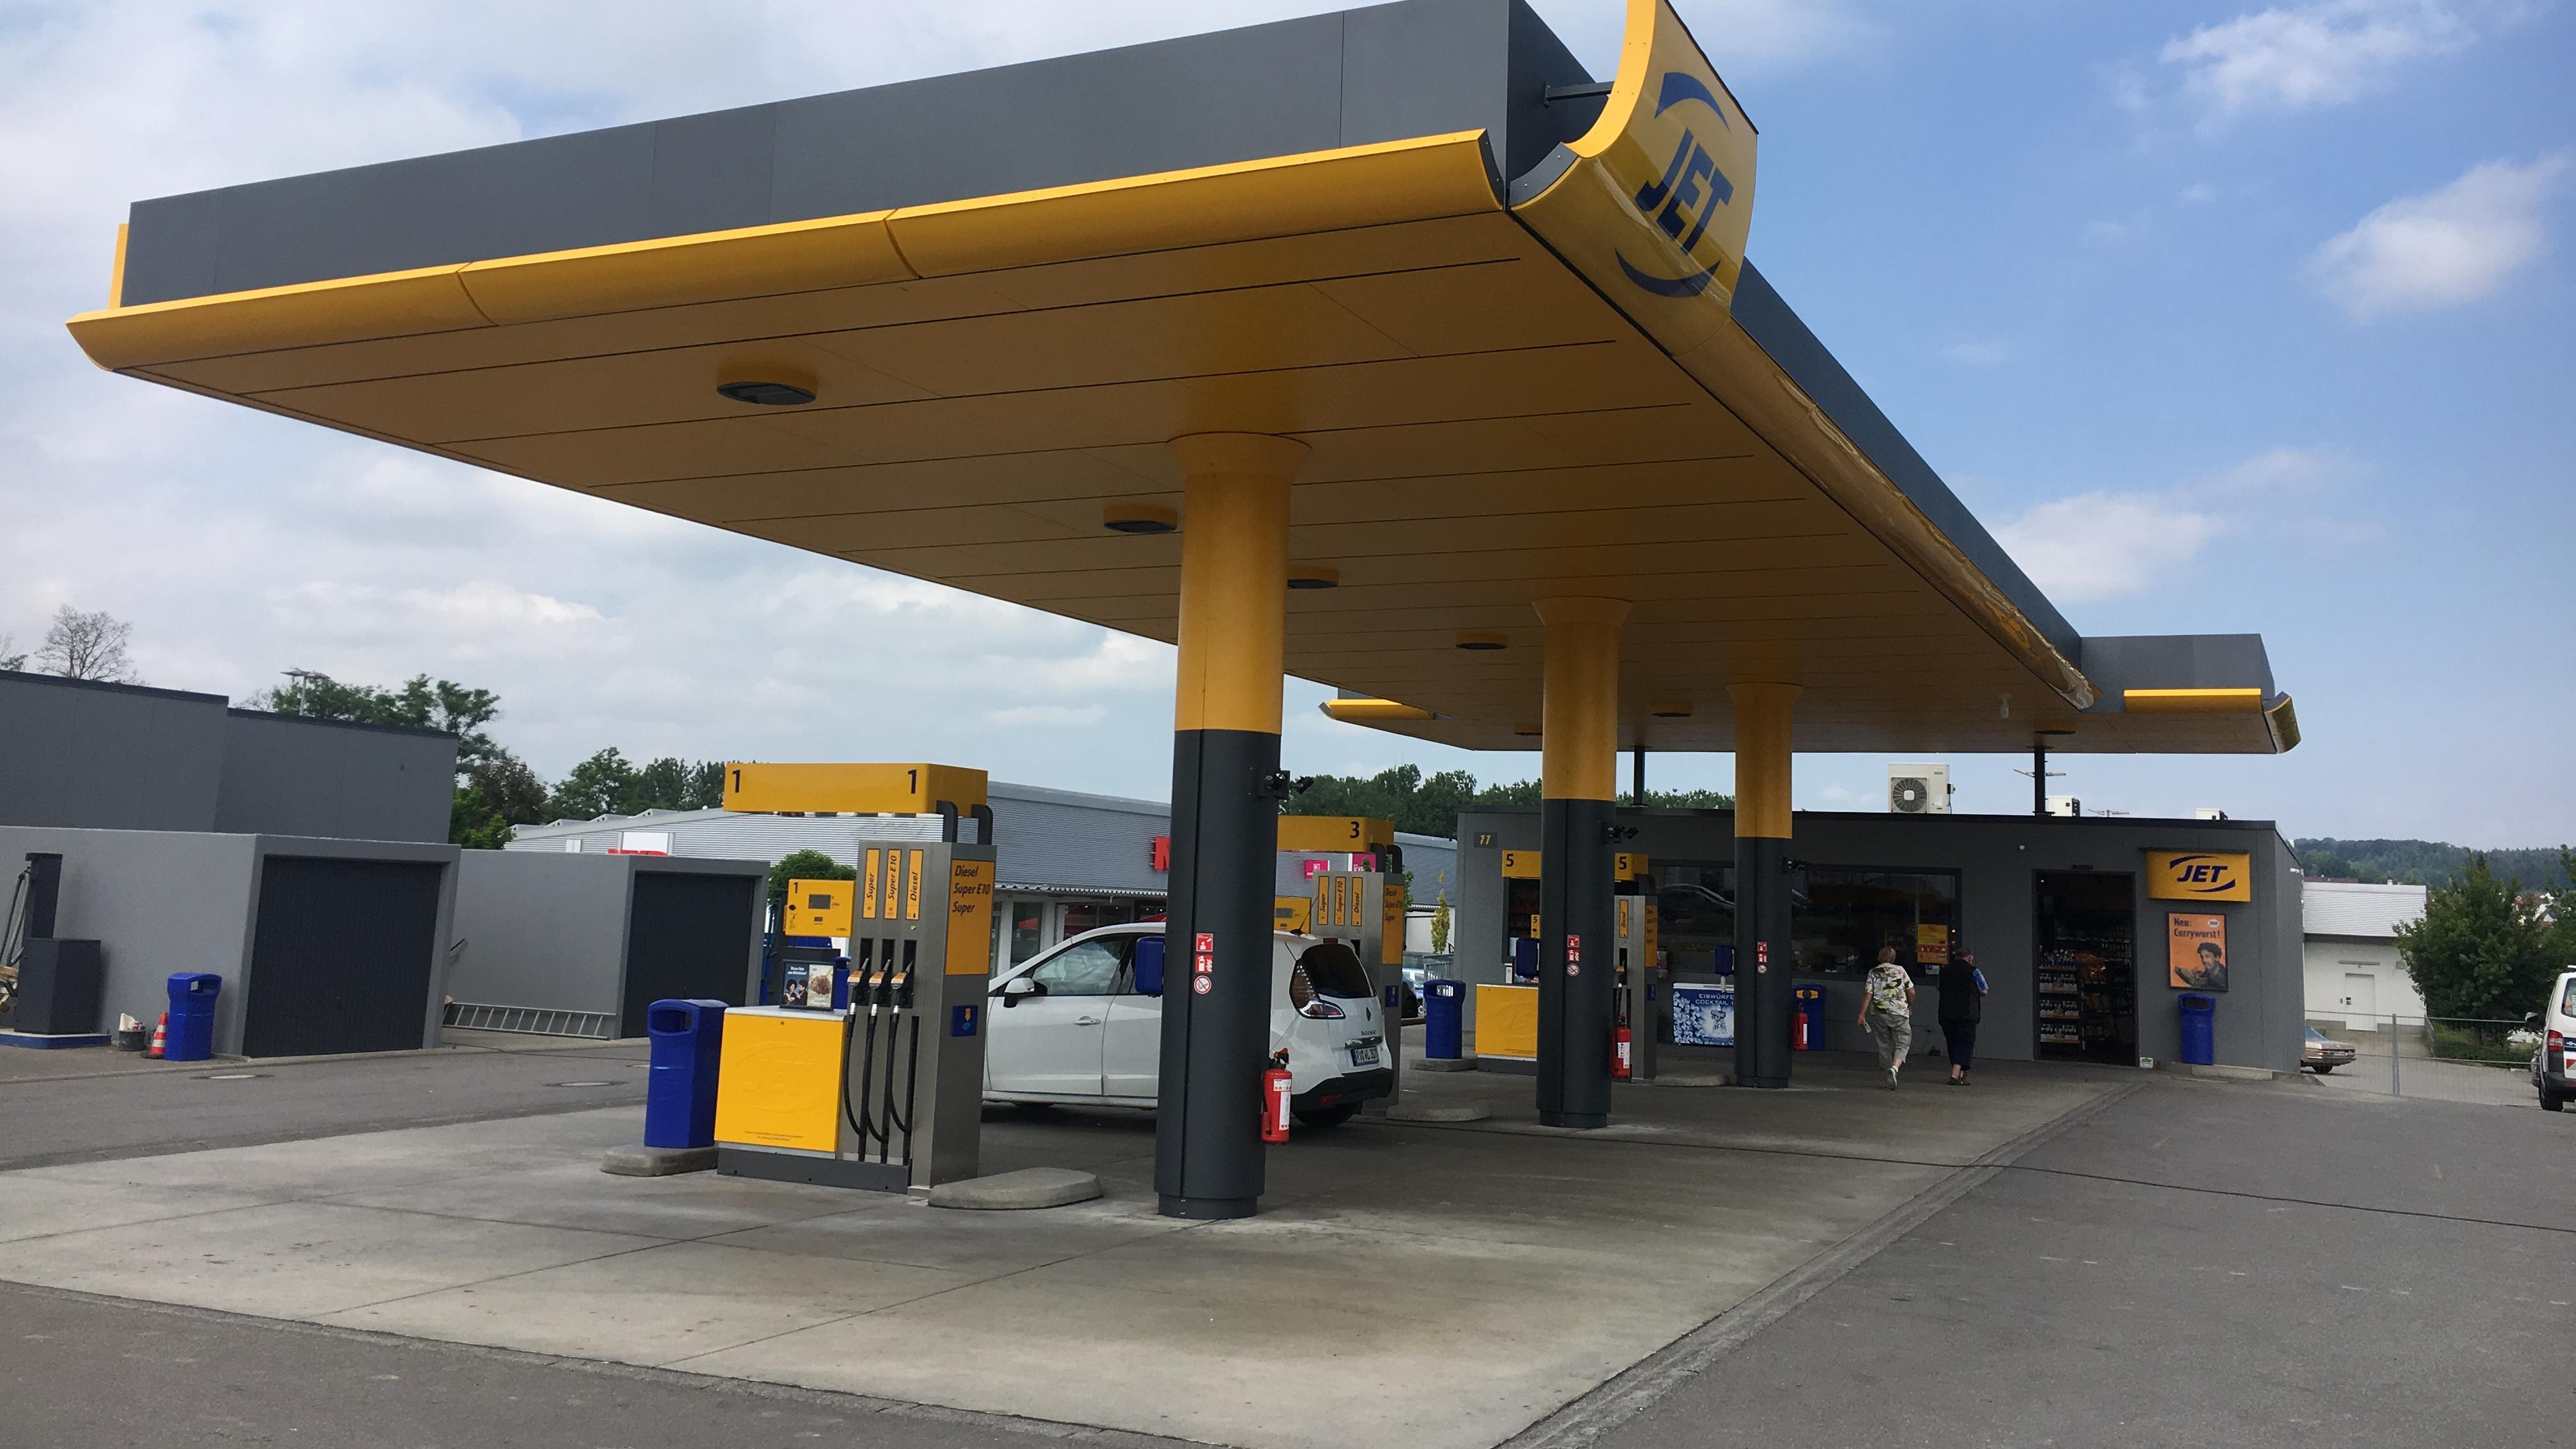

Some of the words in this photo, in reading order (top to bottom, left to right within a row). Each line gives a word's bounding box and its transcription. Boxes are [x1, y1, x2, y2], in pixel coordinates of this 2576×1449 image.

[1634, 128, 1734, 254] JET
[732, 769, 741, 793] 1
[907, 769, 917, 794] 1
[1349, 821, 1360, 839] 3
[1506, 854, 1514, 867] 5
[1618, 856, 1627, 870] 5
[954, 864, 979, 877] Diesel
[2177, 865, 2228, 882] JET
[793, 882, 798, 894] 1
[866, 872, 875, 900] Super
[888, 873, 897, 900] Super
[910, 871, 918, 901] Diesel
[953, 882, 976, 898] Super
[976, 883, 991, 895] E10
[952, 901, 976, 916] Super
[2174, 917, 2192, 927] Neu:
[2174, 928, 2220, 940] Currywurst!
